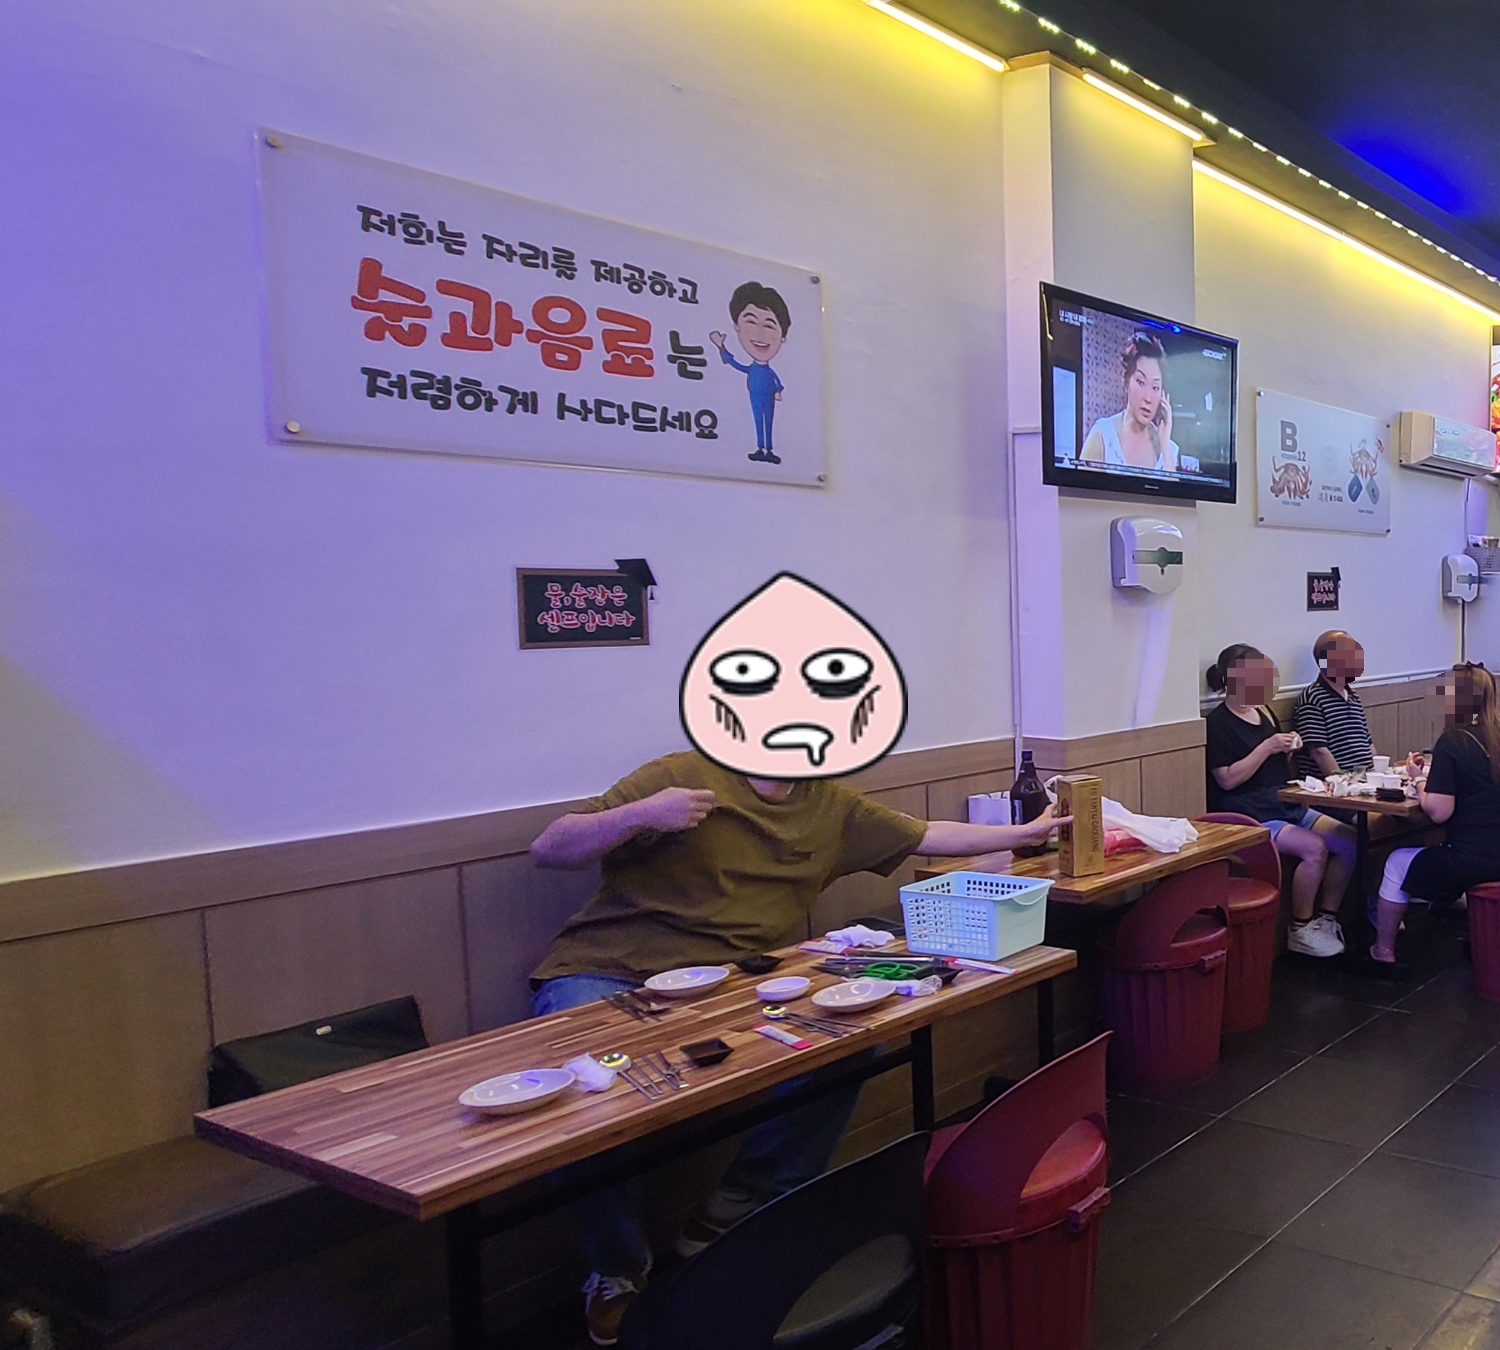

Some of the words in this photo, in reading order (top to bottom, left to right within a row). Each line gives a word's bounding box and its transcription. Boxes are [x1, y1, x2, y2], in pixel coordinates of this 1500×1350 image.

[356, 204, 467, 256] 저희는
[482, 233, 577, 280] 자리를
[590, 259, 699, 305] 제공하고
[360, 366, 539, 415] 저렴하게
[557, 392, 718, 440] 사다드세요
[1280, 420, 1298, 453] B
[1298, 451, 1306, 462] 12
[545, 583, 628, 608] 물,술잔은
[537, 609, 636, 633] 셀프입니다
